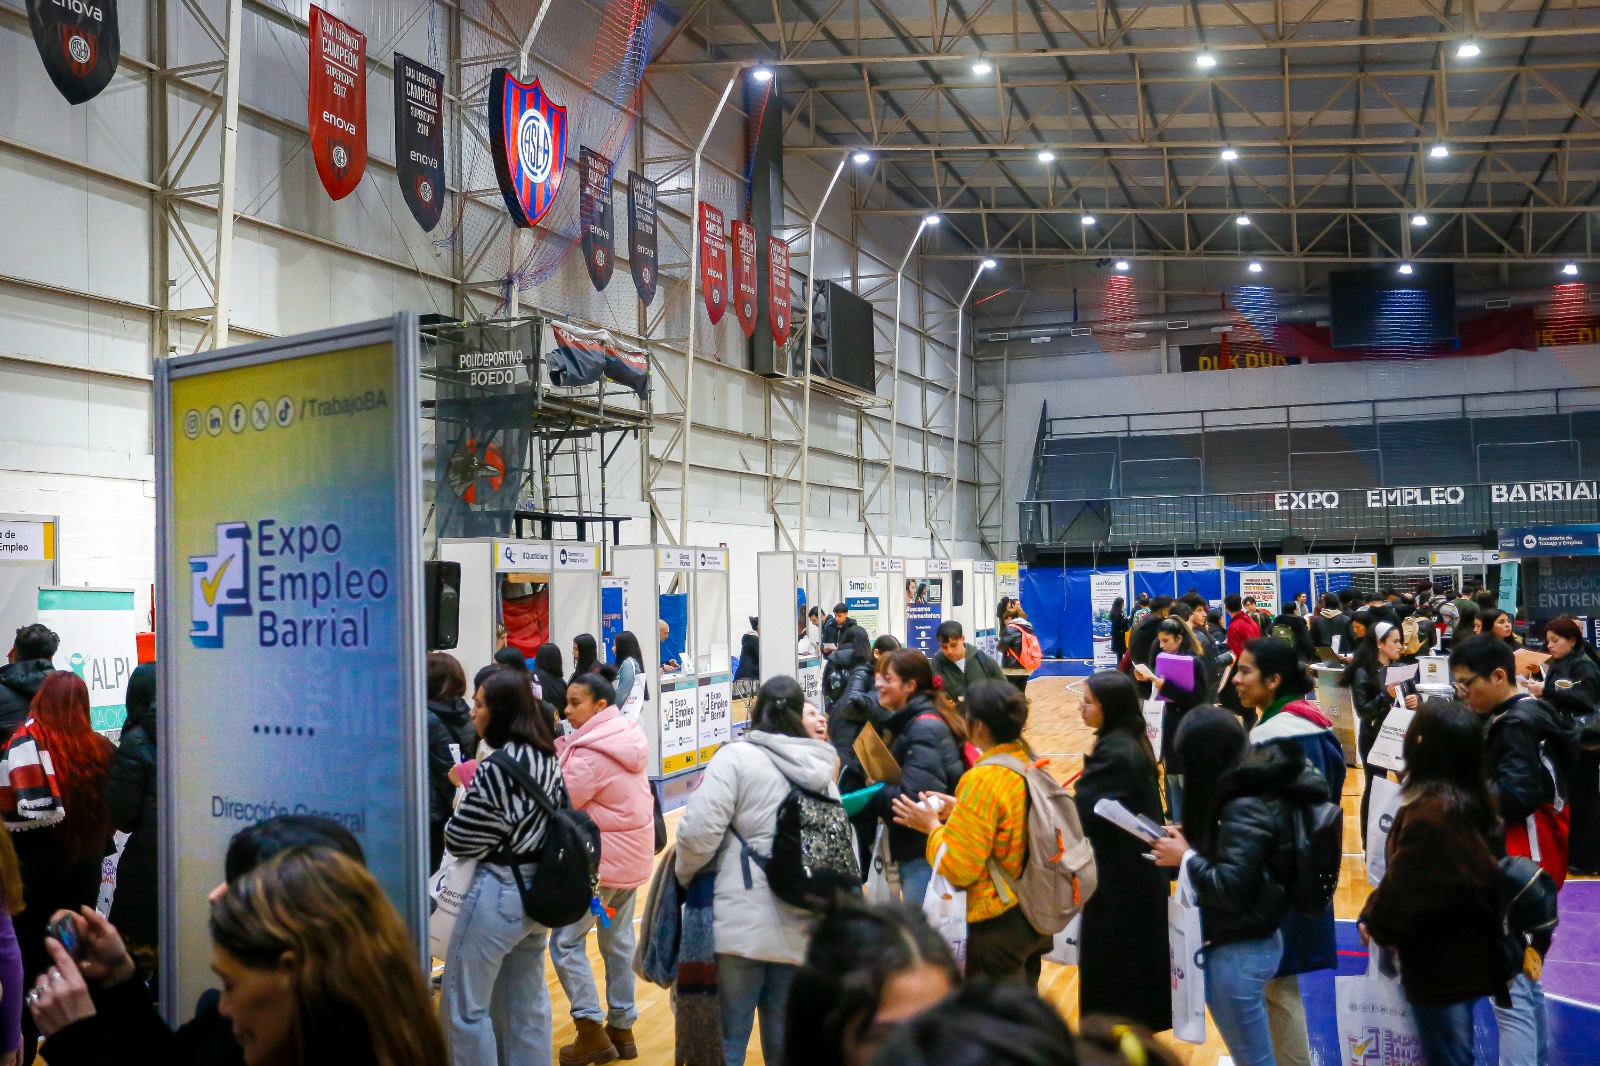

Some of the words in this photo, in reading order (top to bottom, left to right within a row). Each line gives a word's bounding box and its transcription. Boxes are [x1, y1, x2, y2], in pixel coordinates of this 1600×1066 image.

[335, 28, 359, 51] LORENZO
[322, 36, 359, 70] CAMPEÓN
[323, 110, 356, 135] enova
[410, 150, 438, 169] enova
[590, 224, 610, 240] enova
[460, 349, 523, 369] POLIDEPORTIVO
[470, 369, 514, 386] BOEDO
[1274, 491, 1340, 511] EXPO
[1366, 486, 1466, 508] EMPLEO
[4, 529, 16, 539] de
[257, 518, 342, 563] Expo
[257, 560, 389, 608] Empleo
[258, 607, 370, 648] Barrial
